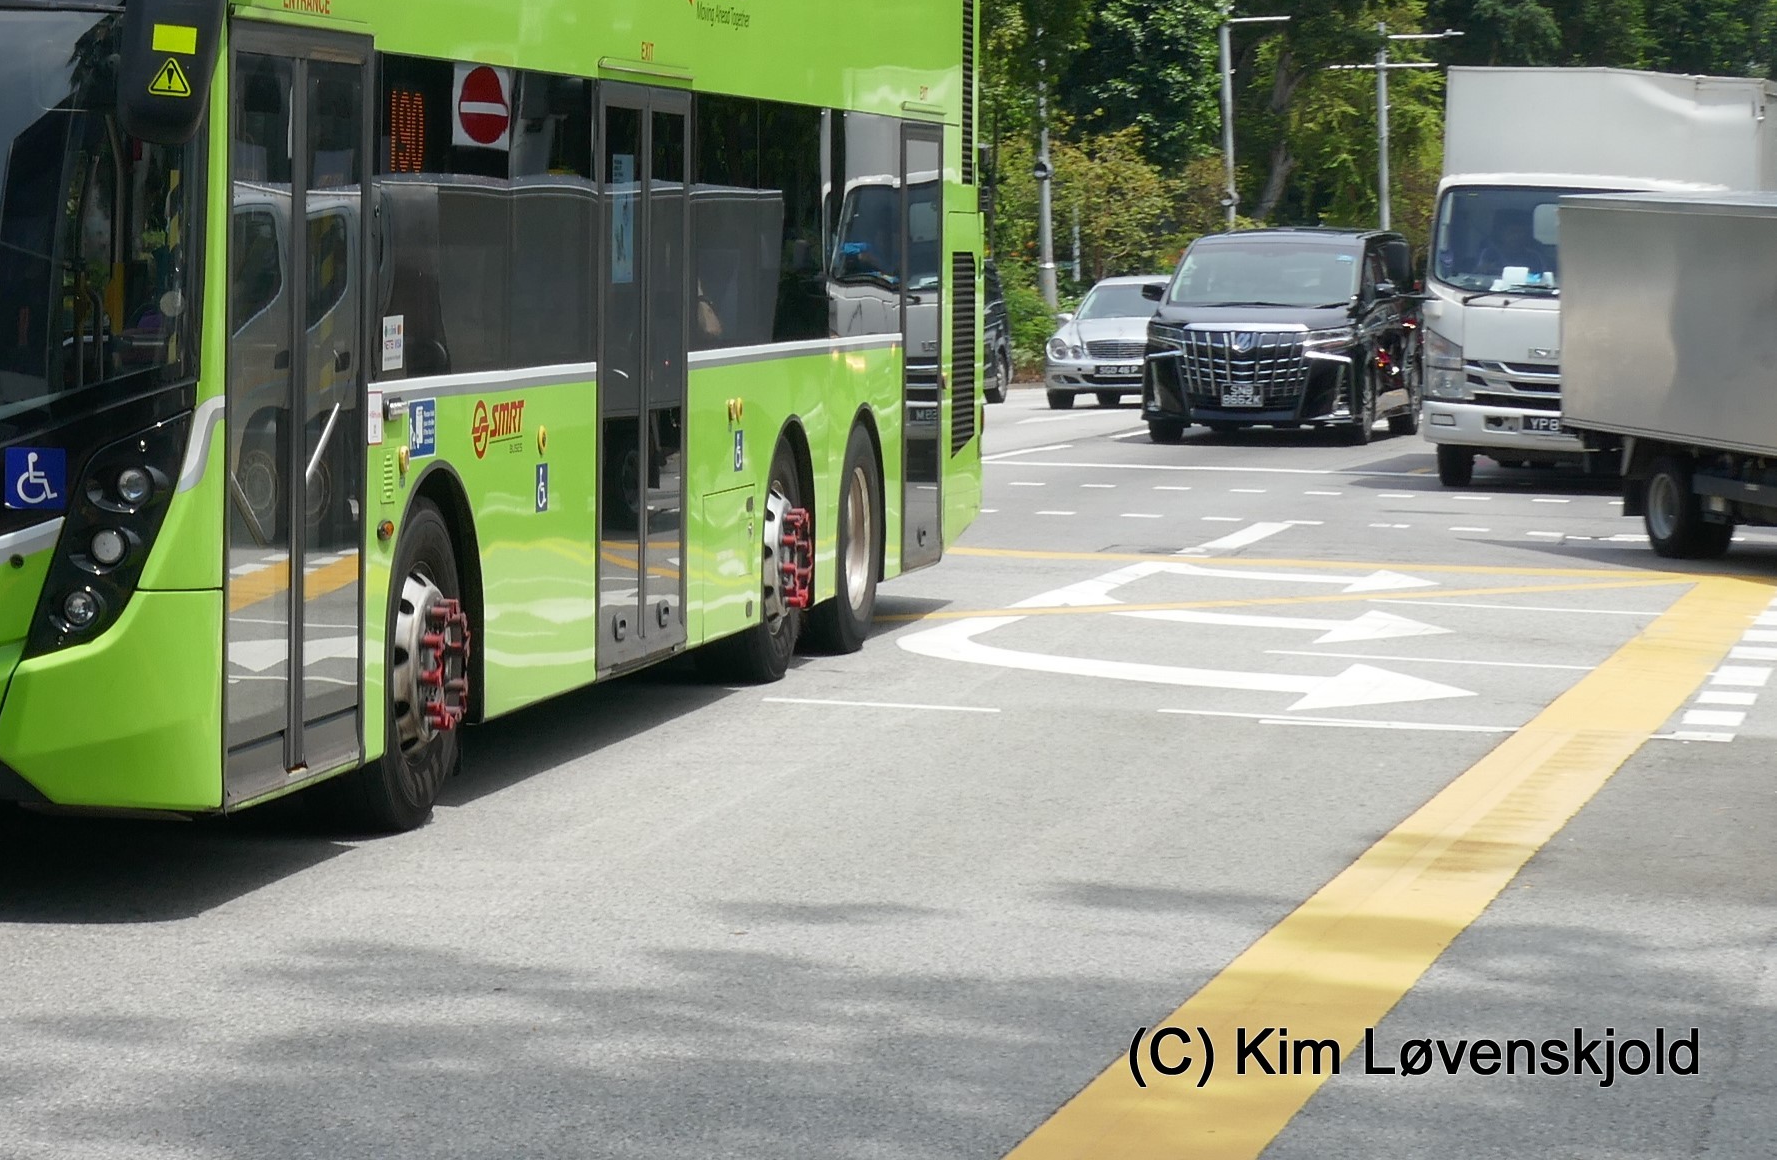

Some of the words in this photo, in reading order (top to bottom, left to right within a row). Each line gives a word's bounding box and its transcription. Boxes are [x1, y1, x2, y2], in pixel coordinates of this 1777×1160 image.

[641, 41, 655, 62] EXIT
[390, 89, 424, 174] 190
[489, 399, 525, 438] SMRT
